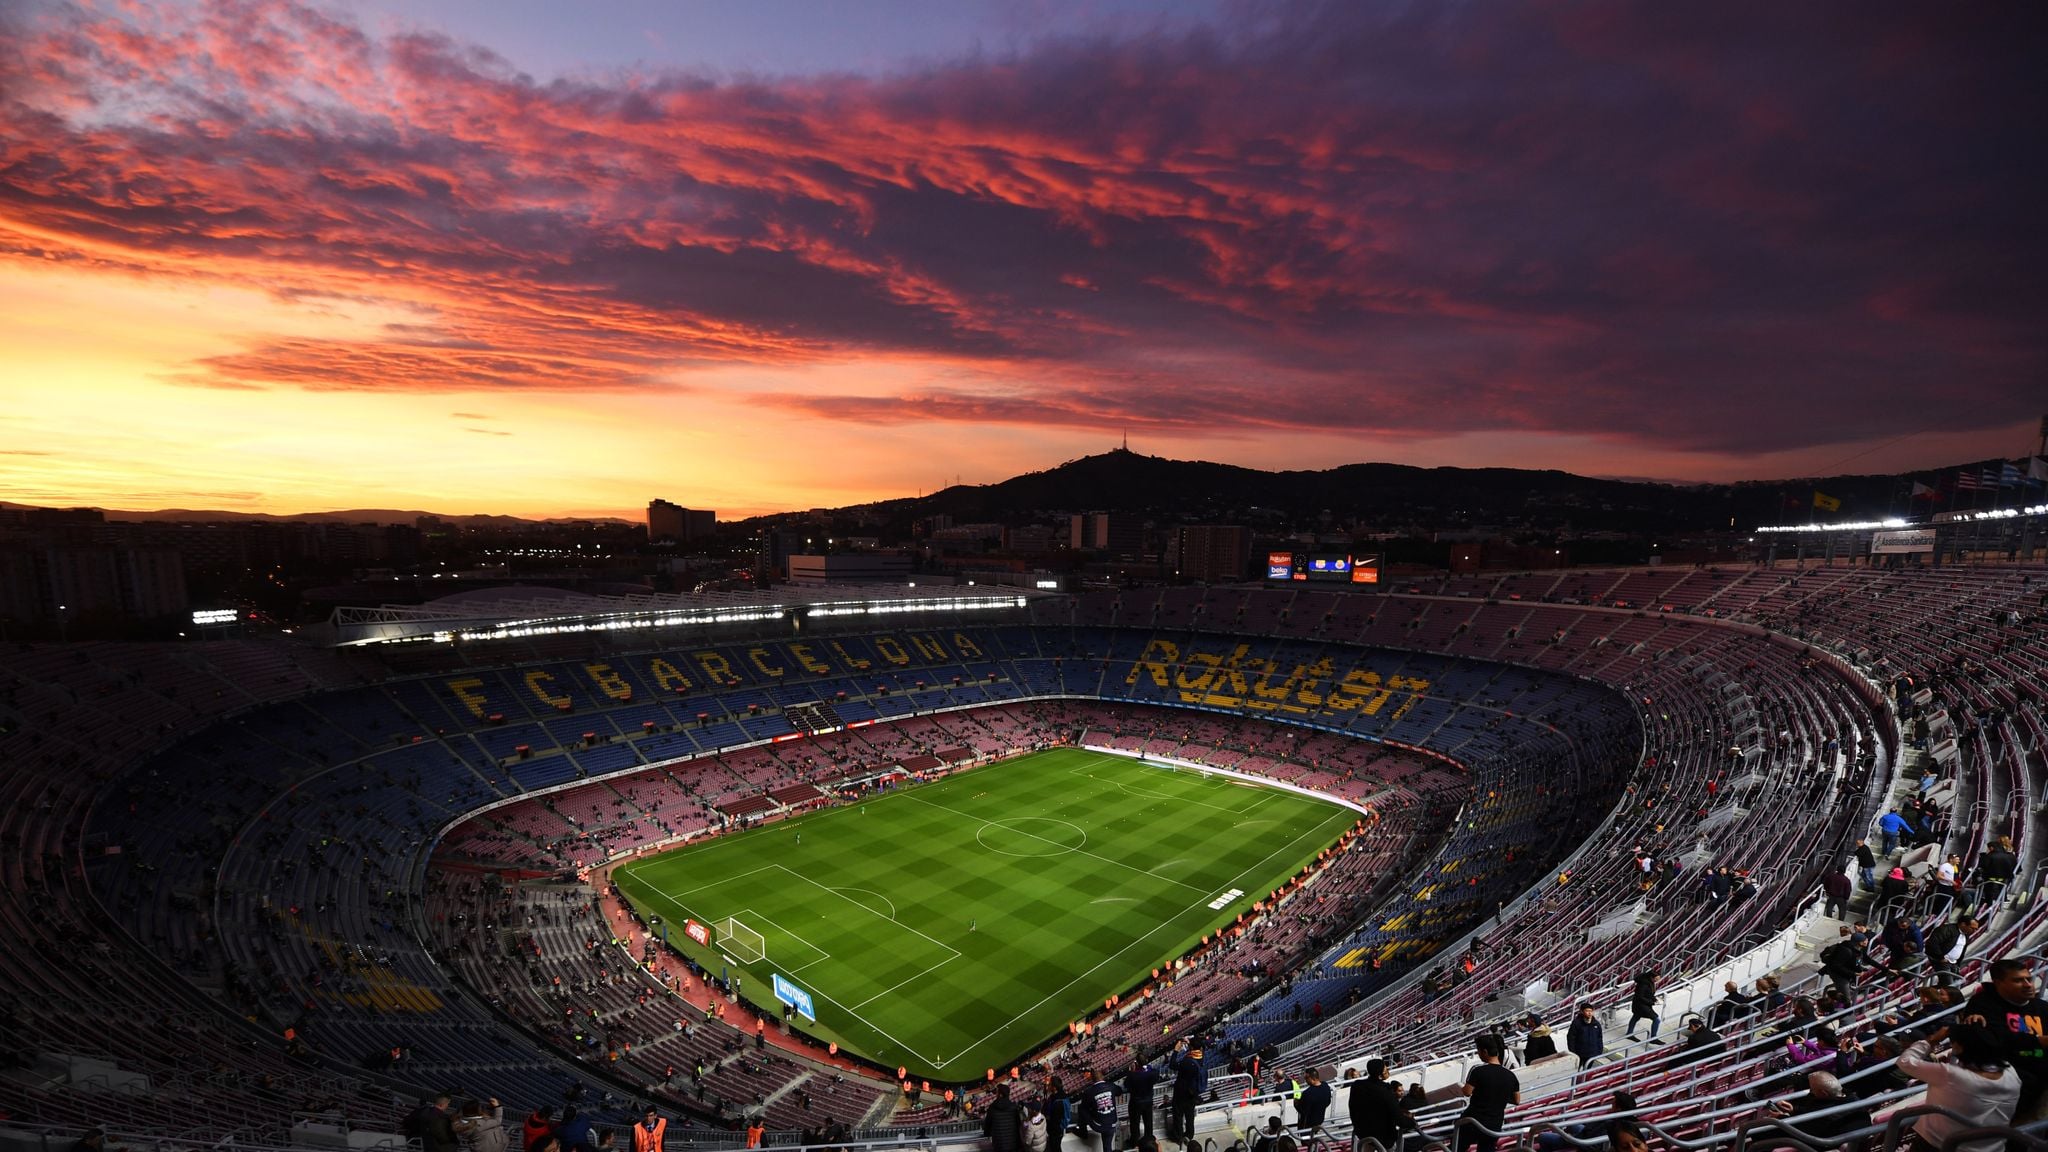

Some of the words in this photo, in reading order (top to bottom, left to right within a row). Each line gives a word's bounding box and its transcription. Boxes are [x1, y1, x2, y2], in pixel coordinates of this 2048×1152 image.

[1271, 566, 1288, 574] beko
[587, 634, 983, 698] BARCELONA
[1126, 640, 1430, 719] Rakuten
